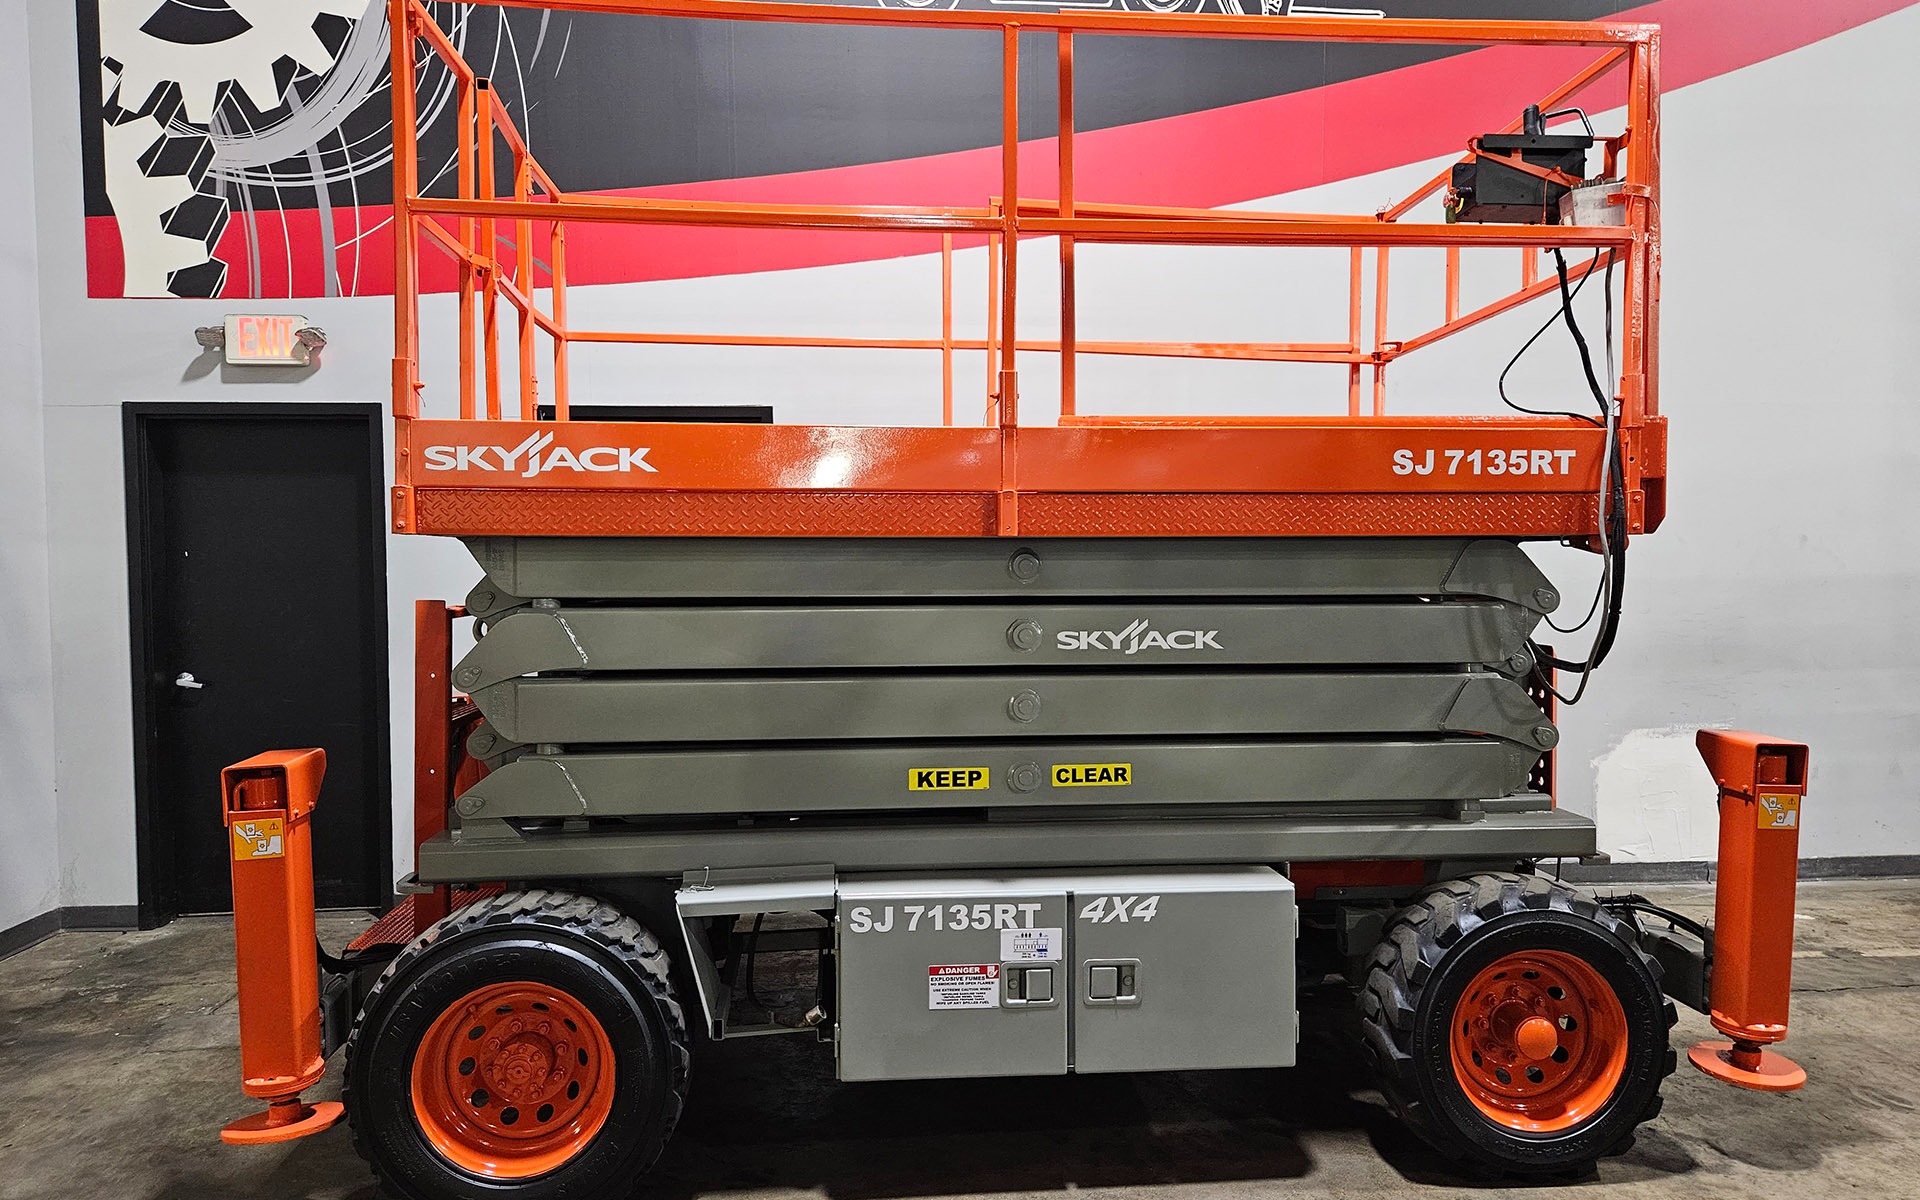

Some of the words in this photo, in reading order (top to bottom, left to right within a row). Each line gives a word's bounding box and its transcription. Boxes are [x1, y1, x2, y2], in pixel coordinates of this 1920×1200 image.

[238, 317, 294, 357] EXIT
[424, 430, 659, 478] SKYJACK
[1392, 449, 1435, 475] SJ
[1445, 449, 1576, 475] 7135RT
[1056, 618, 1224, 654] SKYJACK
[917, 770, 983, 788] KEEP
[1056, 767, 1128, 784] CLEAR
[850, 906, 894, 933] SJ
[904, 903, 1041, 931] 7135RT
[1080, 896, 1160, 923] 4X4
[945, 966, 981, 974] DANGER
